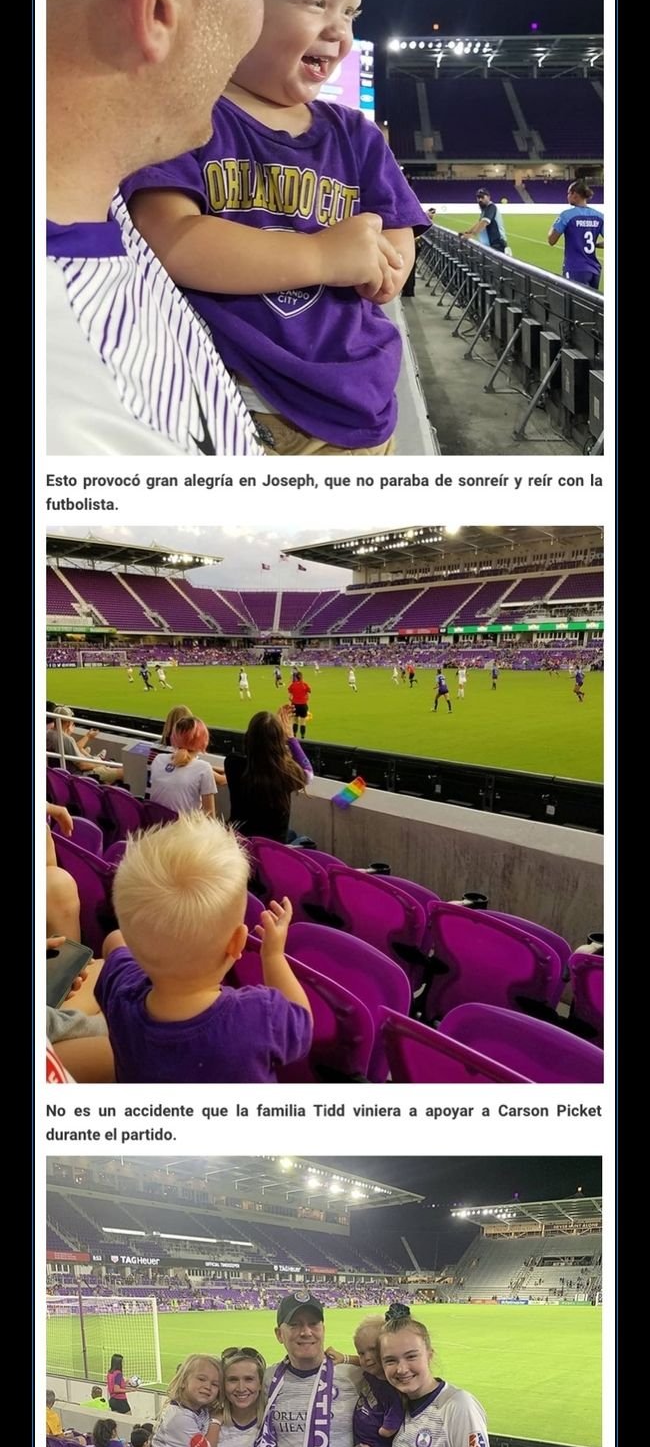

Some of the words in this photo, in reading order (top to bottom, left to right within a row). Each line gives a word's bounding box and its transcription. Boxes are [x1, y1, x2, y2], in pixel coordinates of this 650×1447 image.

[204, 158, 317, 220] ORLANDO
[315, 176, 361, 228] CIT
[583, 230, 595, 254] 3
[277, 294, 298, 306] CITY
